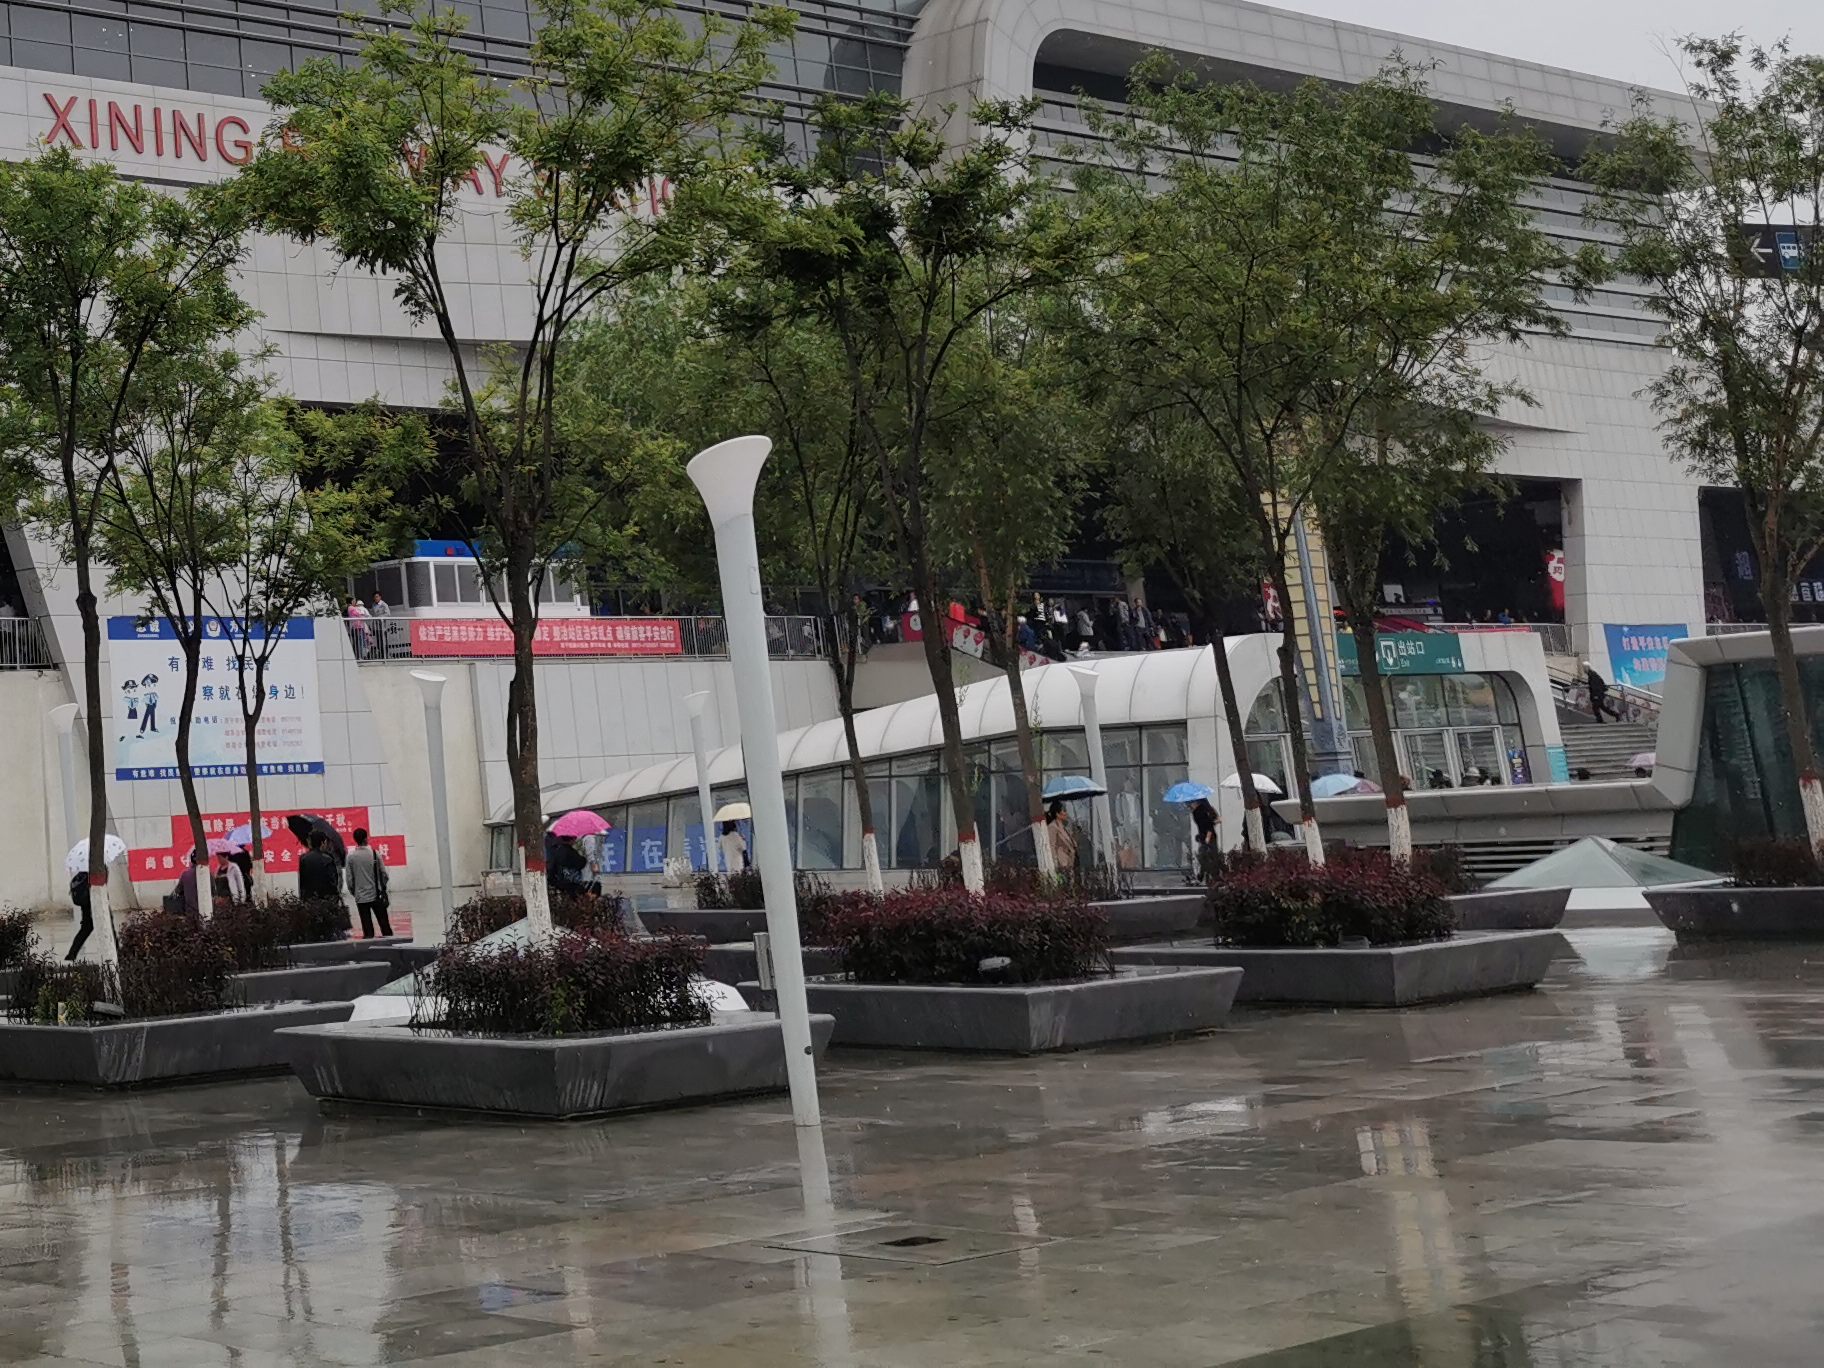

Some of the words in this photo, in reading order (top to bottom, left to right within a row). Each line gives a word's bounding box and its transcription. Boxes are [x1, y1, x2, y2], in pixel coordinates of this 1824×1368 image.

[43, 92, 254, 166] XINING
[1397, 640, 1425, 656] 出站口
[168, 656, 214, 672] 有难
